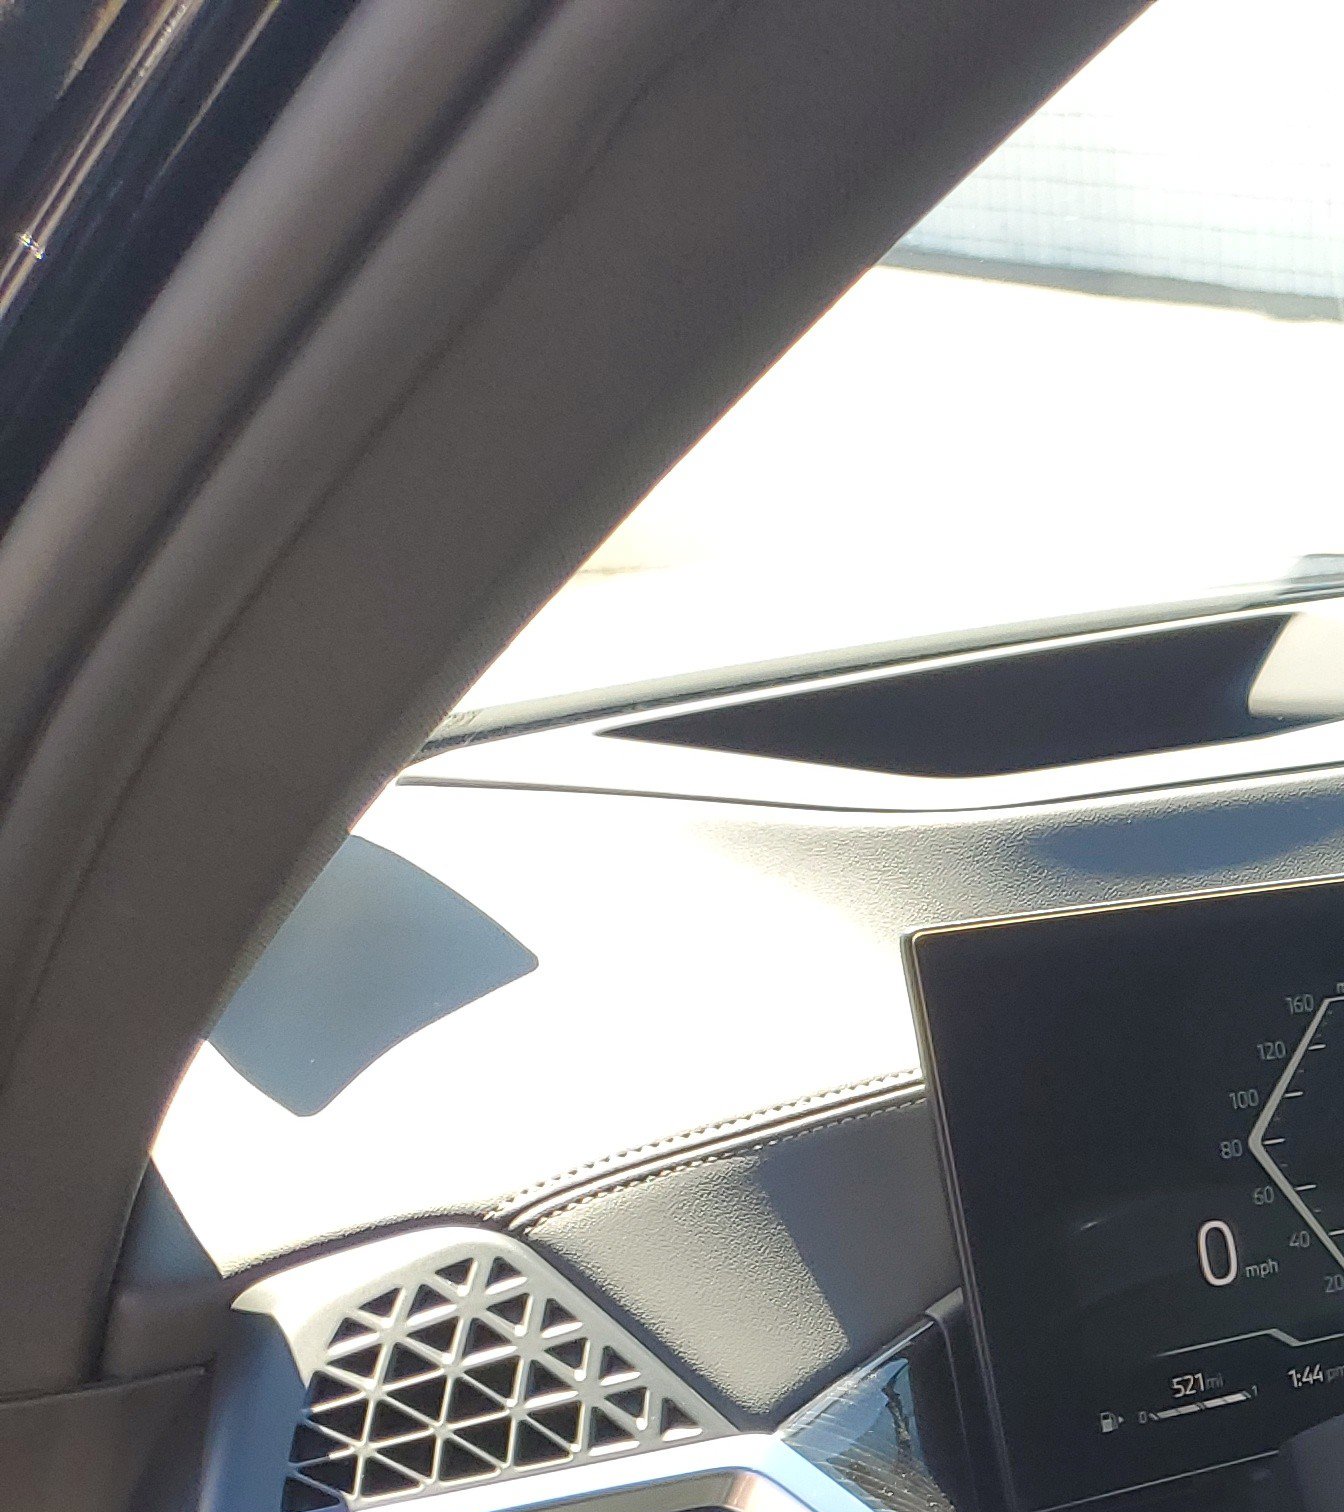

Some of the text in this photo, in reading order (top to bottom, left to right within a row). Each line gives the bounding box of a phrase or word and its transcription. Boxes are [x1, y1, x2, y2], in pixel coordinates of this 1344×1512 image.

[1285, 994, 1315, 1015] 160
[1257, 1041, 1286, 1060] 120
[1229, 1089, 1259, 1110] 100
[1220, 1139, 1242, 1159] 80
[1253, 1185, 1275, 1205] 60
[1289, 1230, 1310, 1248] 40
[1198, 1219, 1279, 1287] 0 mph
[1324, 1273, 1344, 1293] 20
[1171, 1373, 1205, 1398] 521
[1287, 1363, 1324, 1388] 1:44
